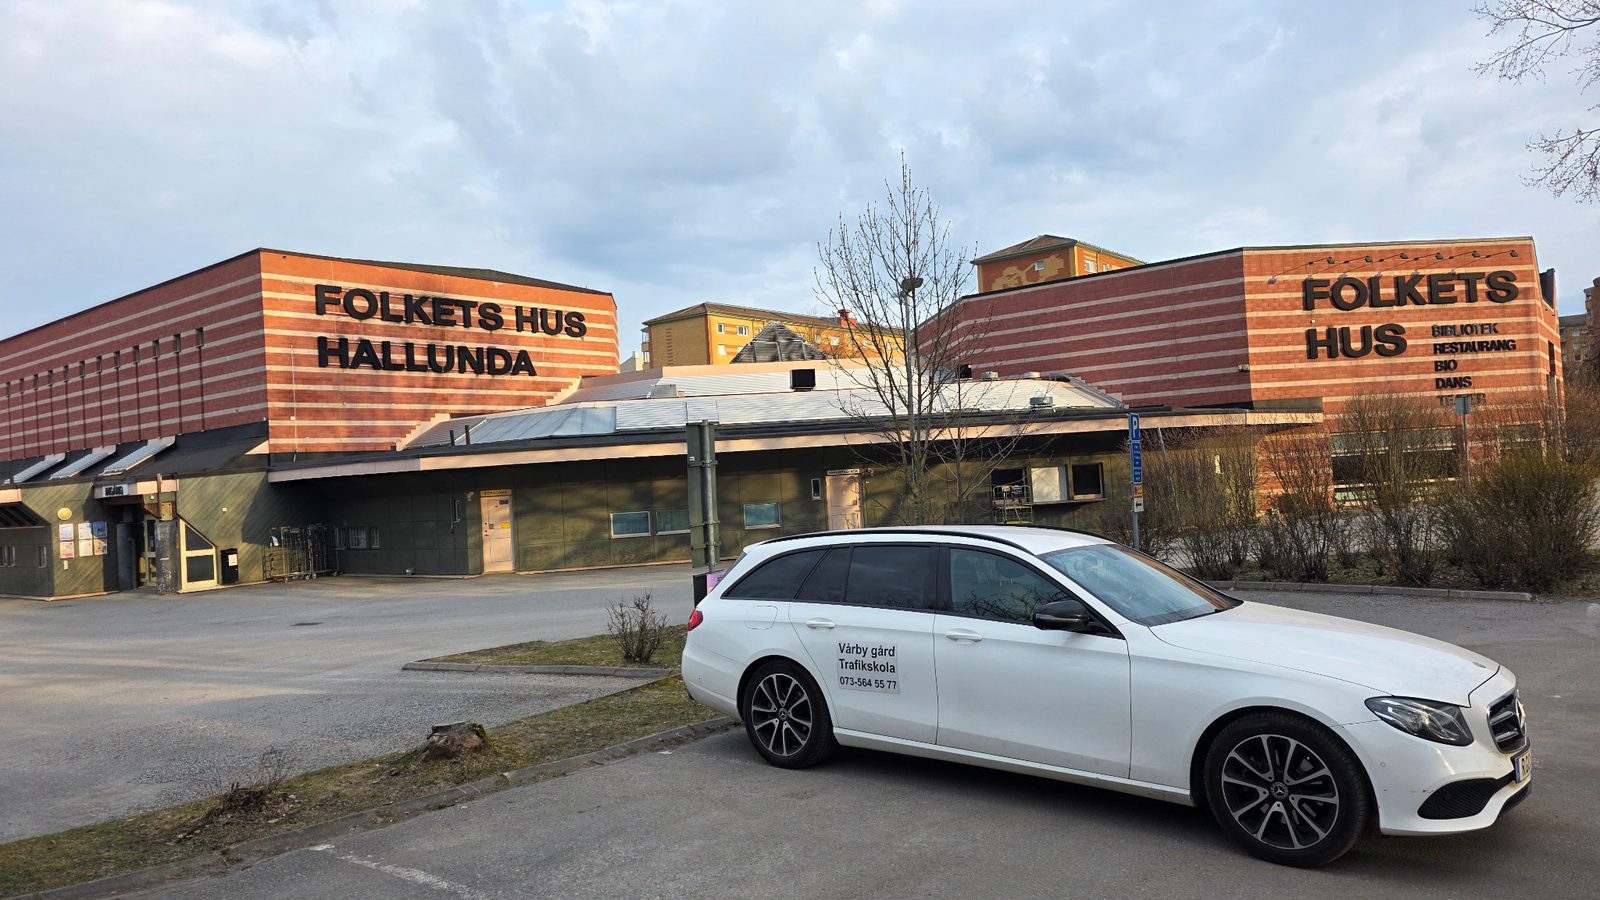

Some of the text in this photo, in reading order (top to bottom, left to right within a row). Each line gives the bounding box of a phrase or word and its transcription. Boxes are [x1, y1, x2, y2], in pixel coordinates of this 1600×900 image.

[1302, 270, 1519, 312] FOLKETS
[315, 284, 587, 338] FOLKETS HUS
[1431, 322, 1499, 337] BIBLIOTEK
[1305, 323, 1408, 359] HUS
[1433, 339, 1517, 354] RESTAURANG
[317, 336, 537, 376] HALLUNDA
[1434, 359, 1458, 372] BIO
[1435, 376, 1473, 389] DANS
[1132, 416, 1138, 438] P
[838, 643, 895, 658] Vårby gård
[838, 659, 895, 673] Trafikskola
[840, 676, 897, 689] 073-564 55 77
